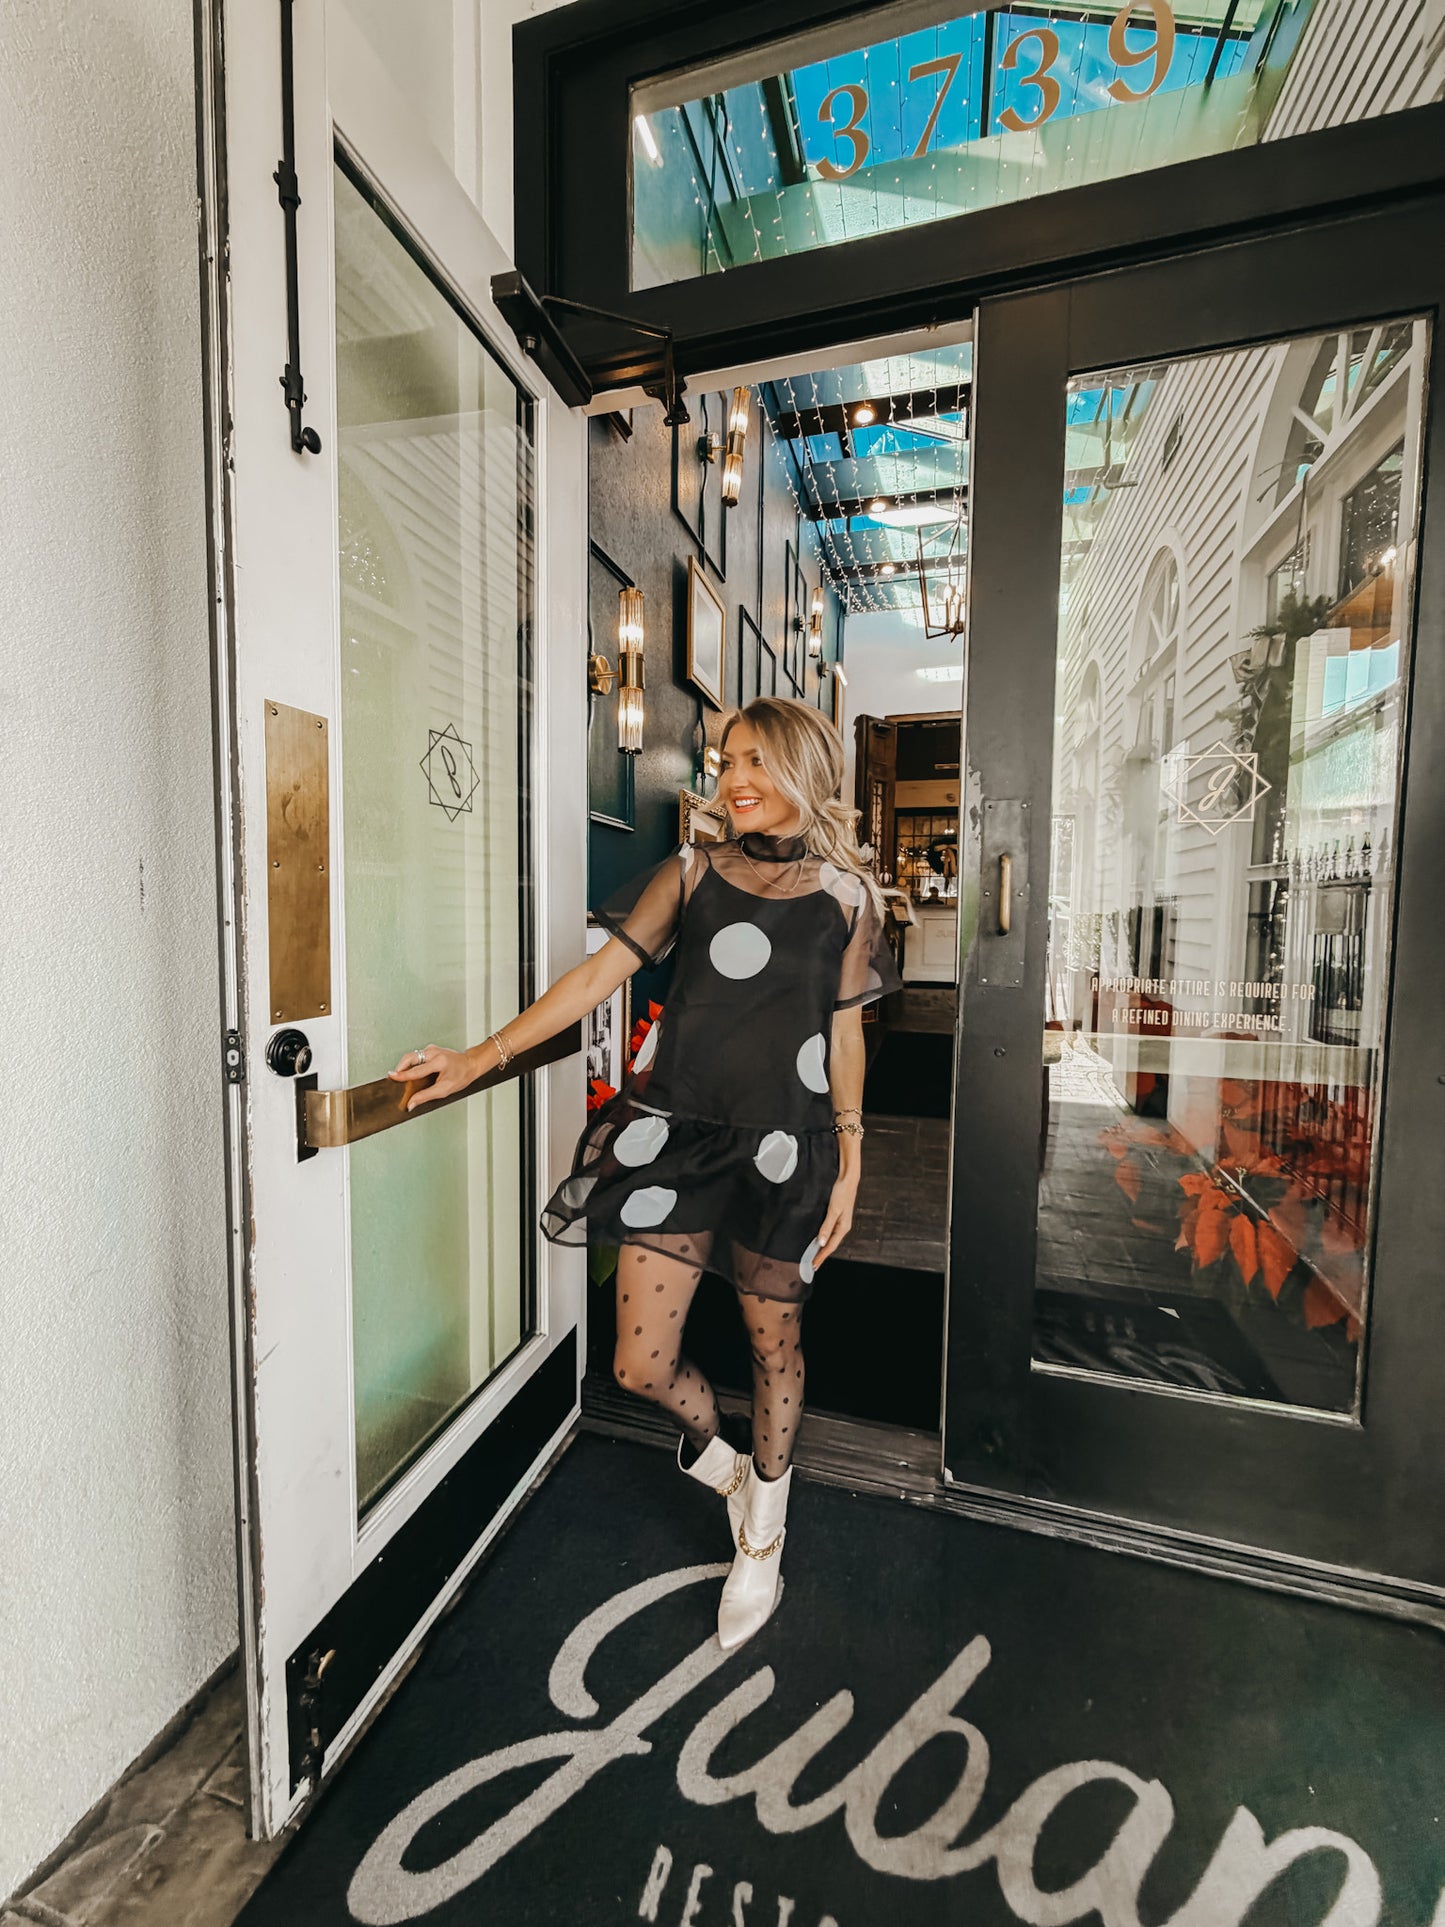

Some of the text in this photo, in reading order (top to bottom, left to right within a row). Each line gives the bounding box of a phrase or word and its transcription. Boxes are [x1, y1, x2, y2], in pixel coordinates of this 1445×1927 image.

[815, 0, 1176, 180] 3739
[1091, 977, 1316, 1000] APPROPRIATE ATTIRE IS REQUIRED FOR
[1112, 1008, 1292, 1032] A REFINED DINING EXPERIENCE.
[346, 1563, 1445, 1927] Juban
